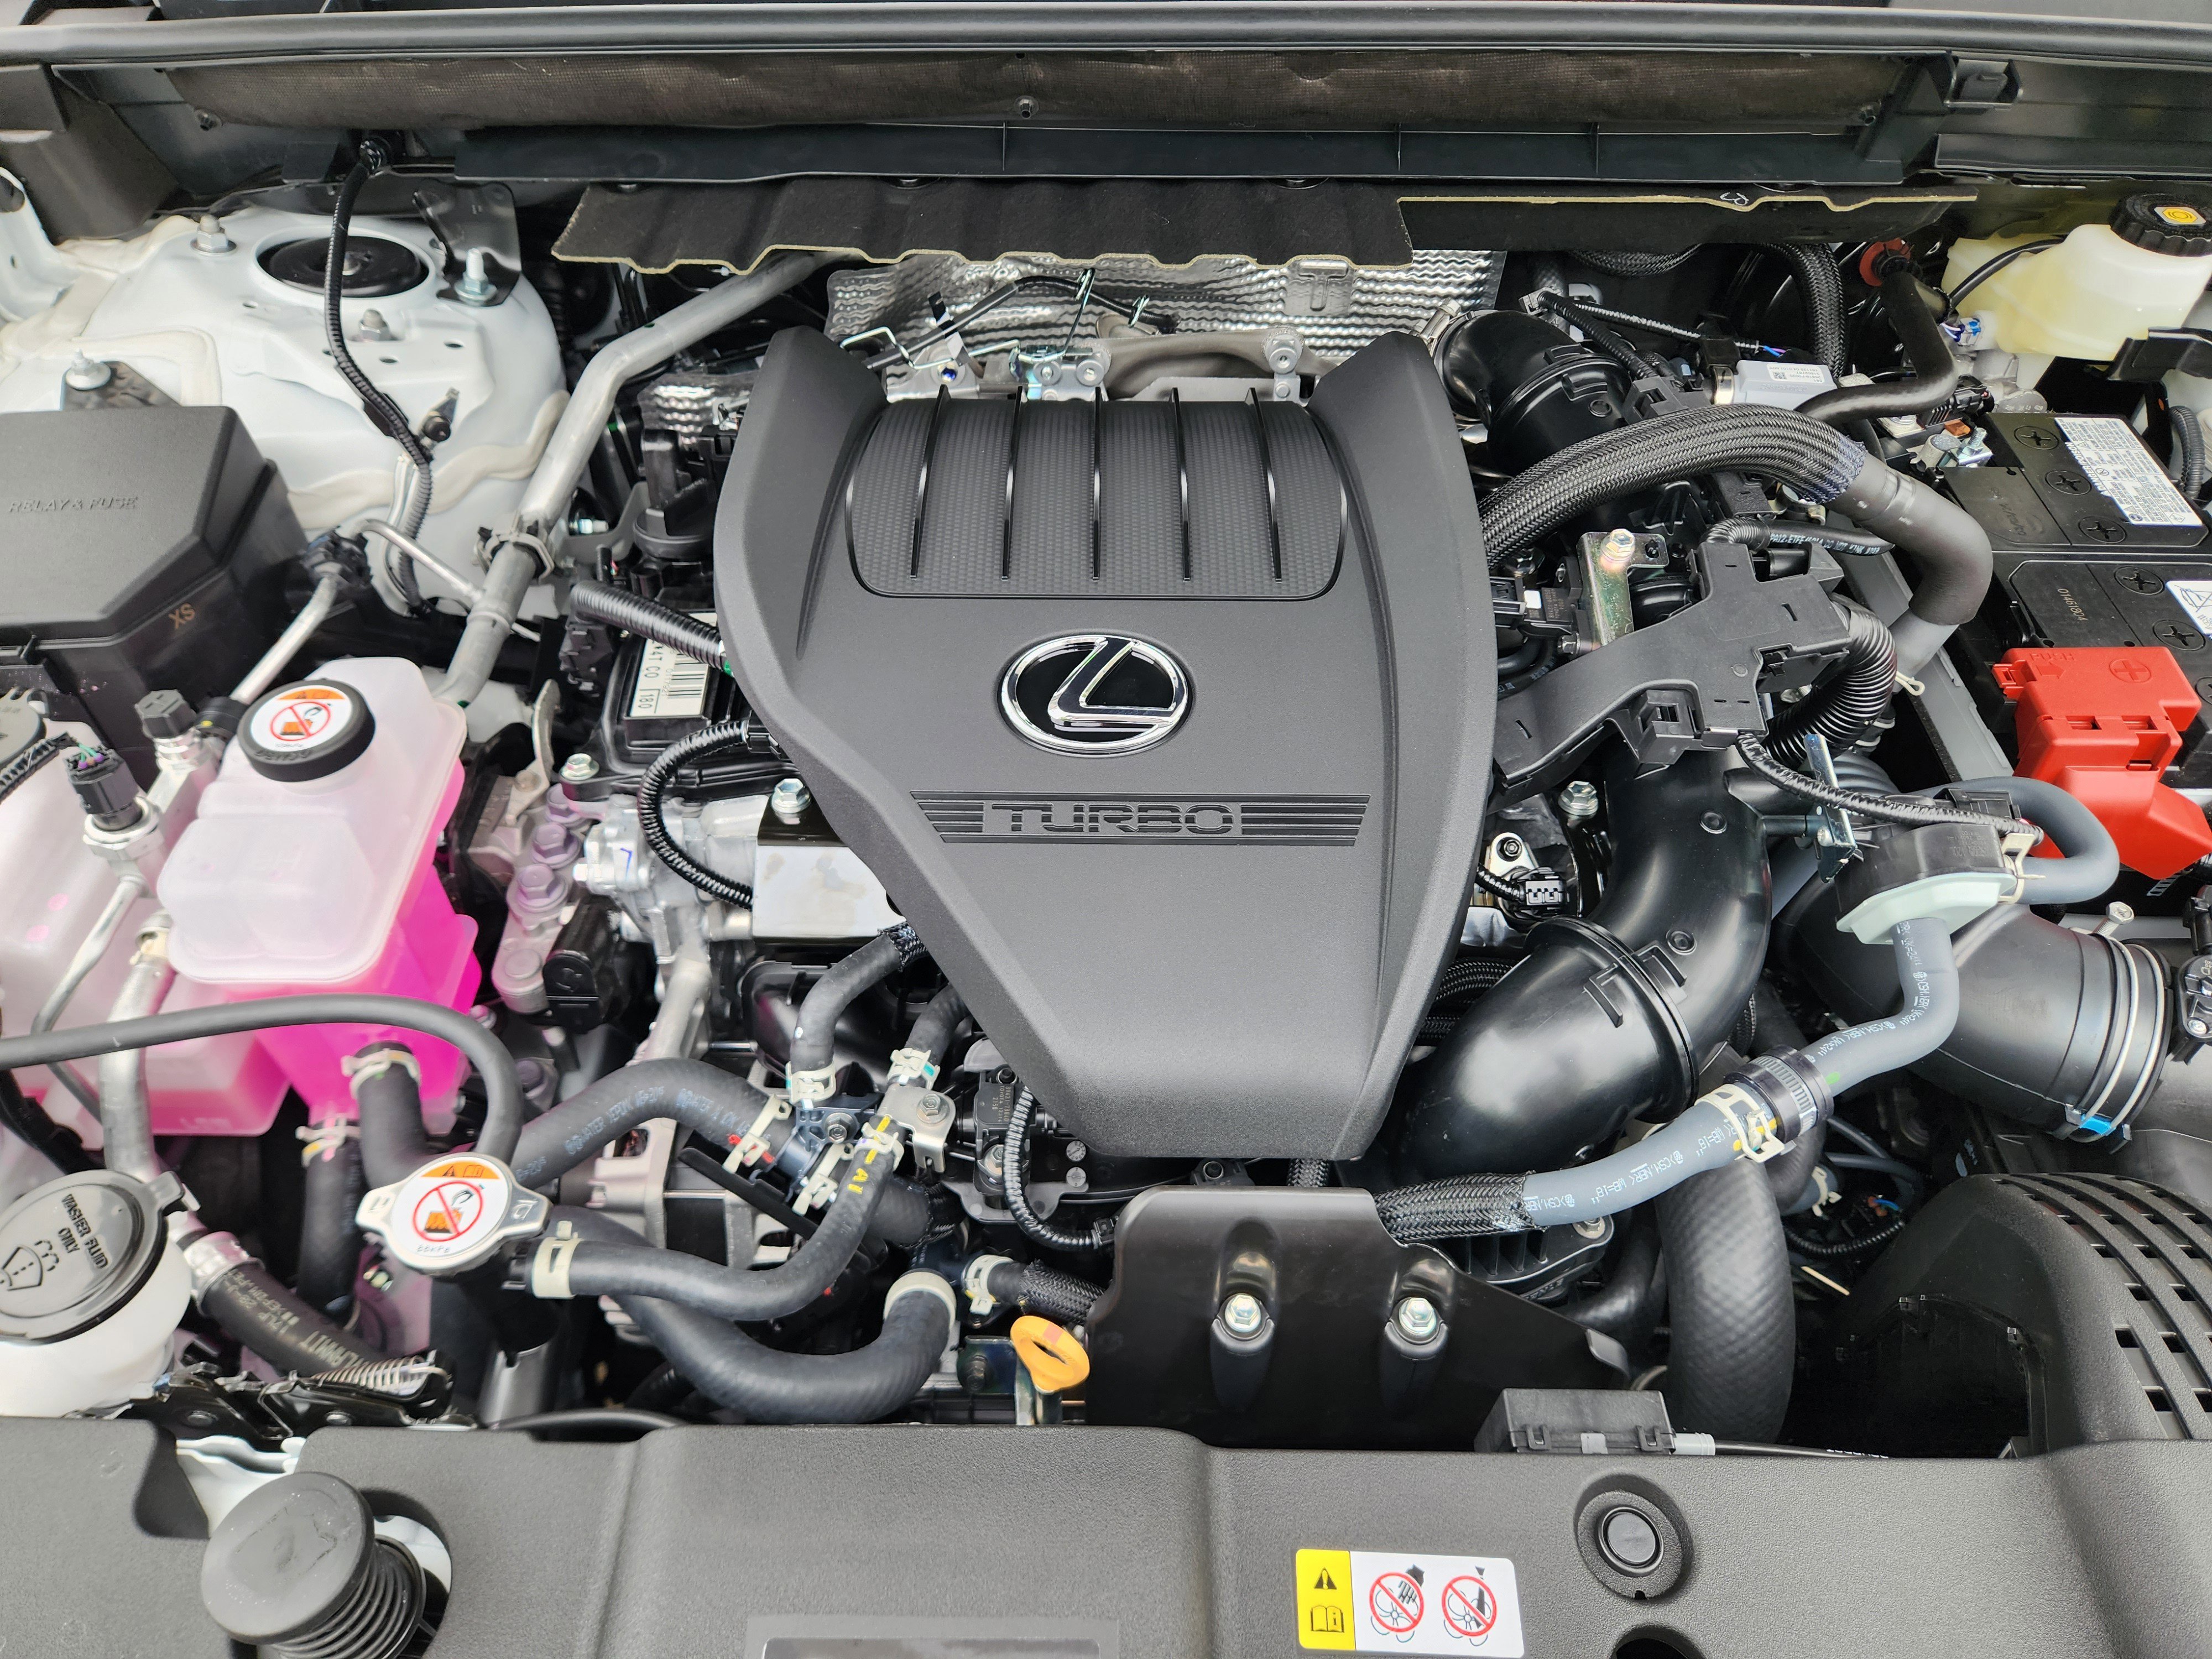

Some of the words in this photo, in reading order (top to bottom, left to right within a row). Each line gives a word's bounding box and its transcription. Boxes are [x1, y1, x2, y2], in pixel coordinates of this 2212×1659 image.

[9, 498, 71, 513] RELAY
[72, 497, 84, 510] &
[88, 496, 139, 510] FUSE
[168, 602, 196, 629] XS
[2029, 653, 2076, 661] PUSH
[638, 693, 654, 708] 180
[990, 803, 1234, 834] TURBO
[57, 1227, 80, 1254] ONLY
[61, 1193, 92, 1238] WASHER
[84, 1236, 109, 1270] FLUID
